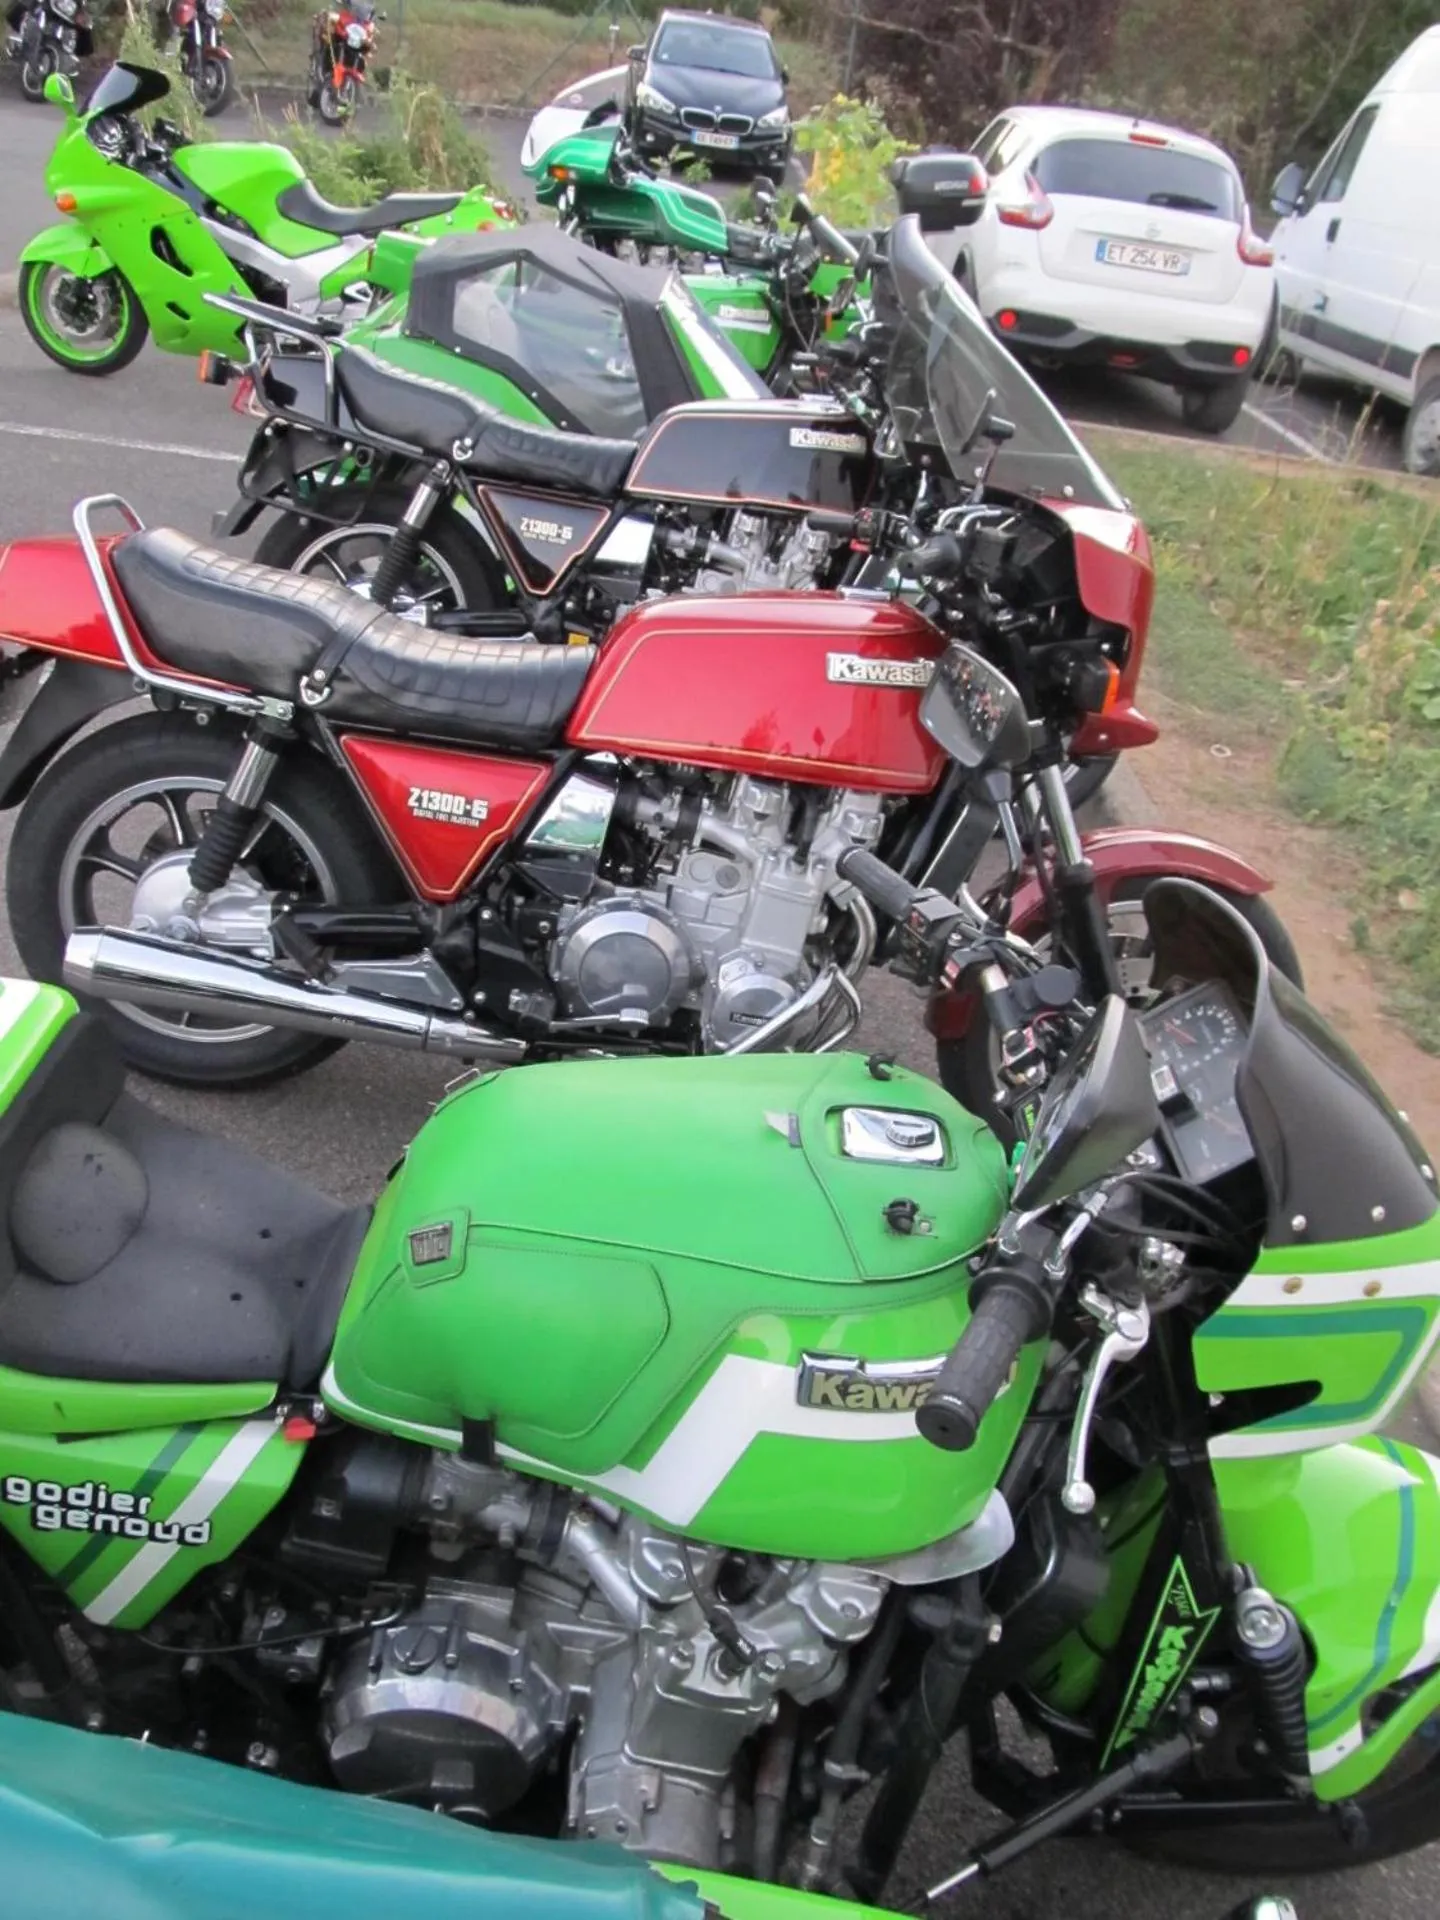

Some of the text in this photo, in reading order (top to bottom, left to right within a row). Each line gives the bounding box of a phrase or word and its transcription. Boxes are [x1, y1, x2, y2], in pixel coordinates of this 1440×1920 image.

[1107, 243, 1180, 269] ET 254 VR
[407, 787, 488, 820] Z1300-6
[811, 1371, 935, 1410] Kawa
[6, 1476, 151, 1515] godier
[36, 1504, 210, 1544] genoud
